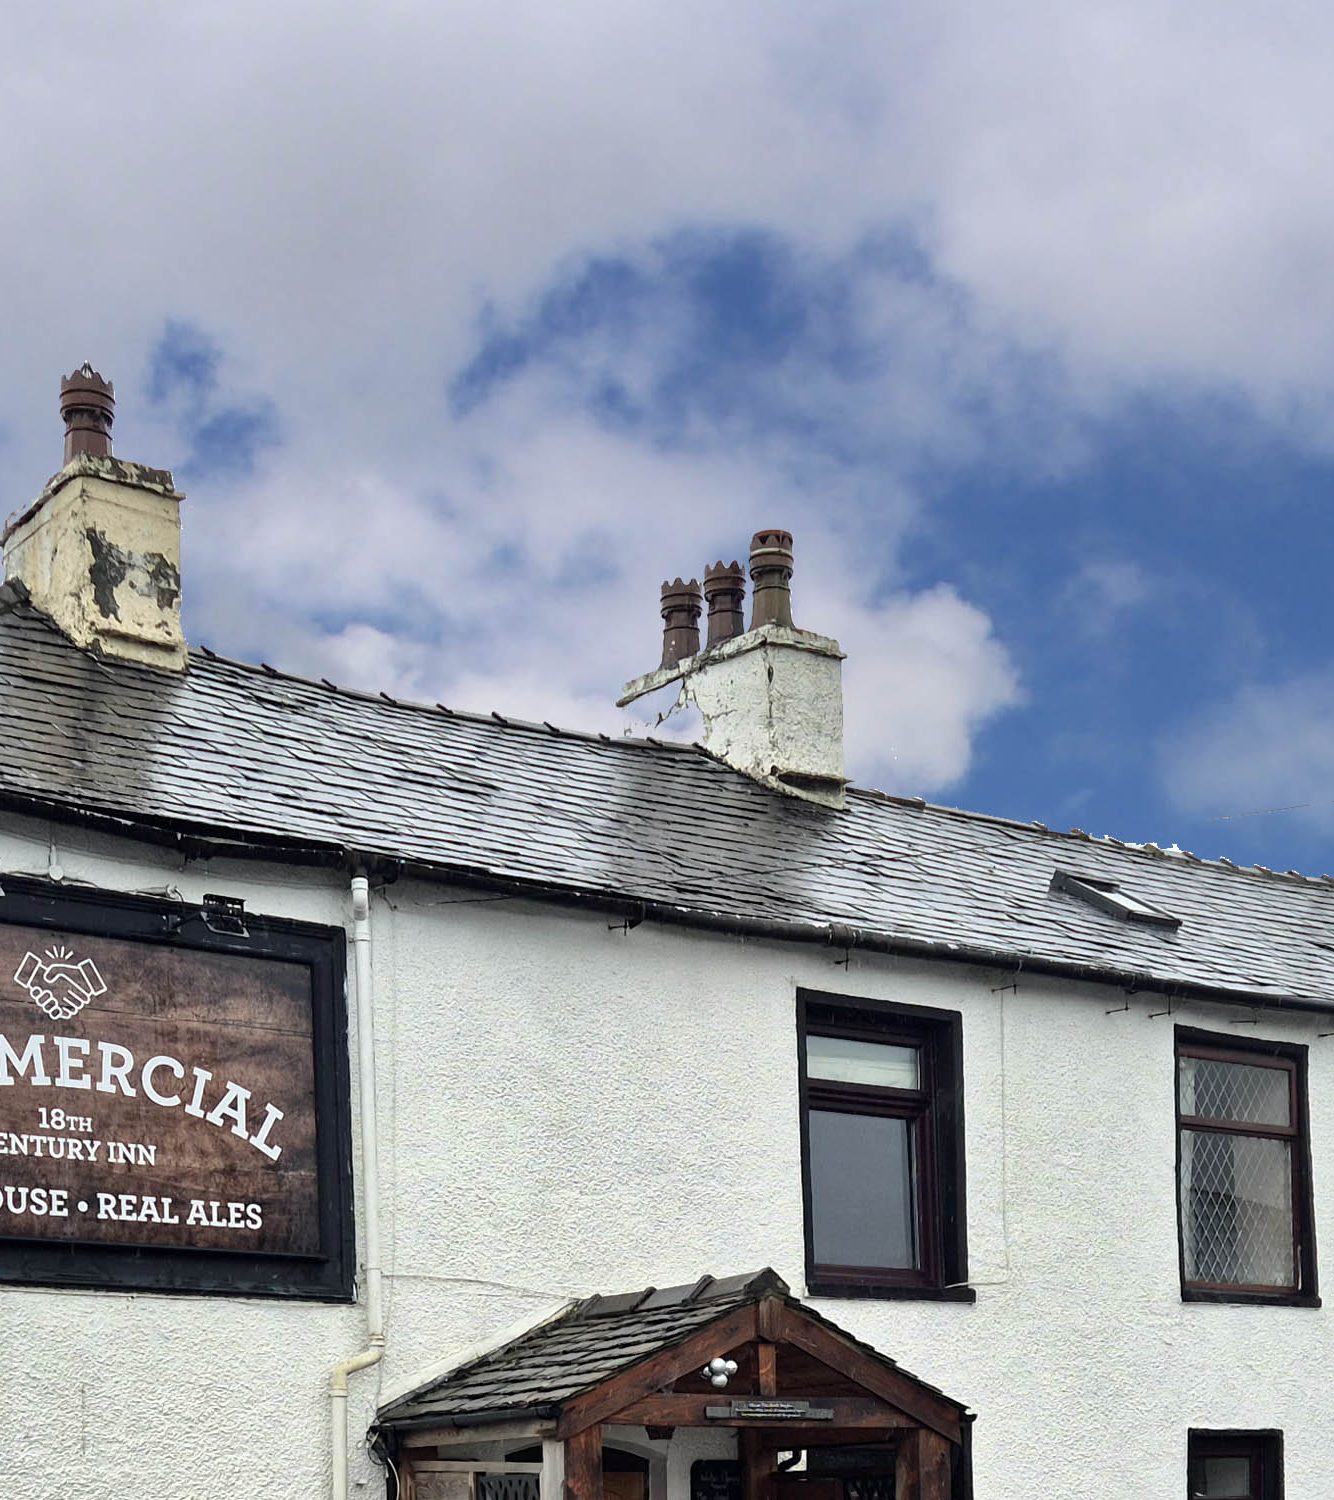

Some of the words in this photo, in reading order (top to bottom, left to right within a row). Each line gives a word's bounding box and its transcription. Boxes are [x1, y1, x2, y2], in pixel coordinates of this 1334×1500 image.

[38, 1107, 93, 1133] 18TH
[107, 1141, 157, 1167] INN
[96, 1195, 179, 1225] REAL
[186, 1202, 263, 1230] ALES
